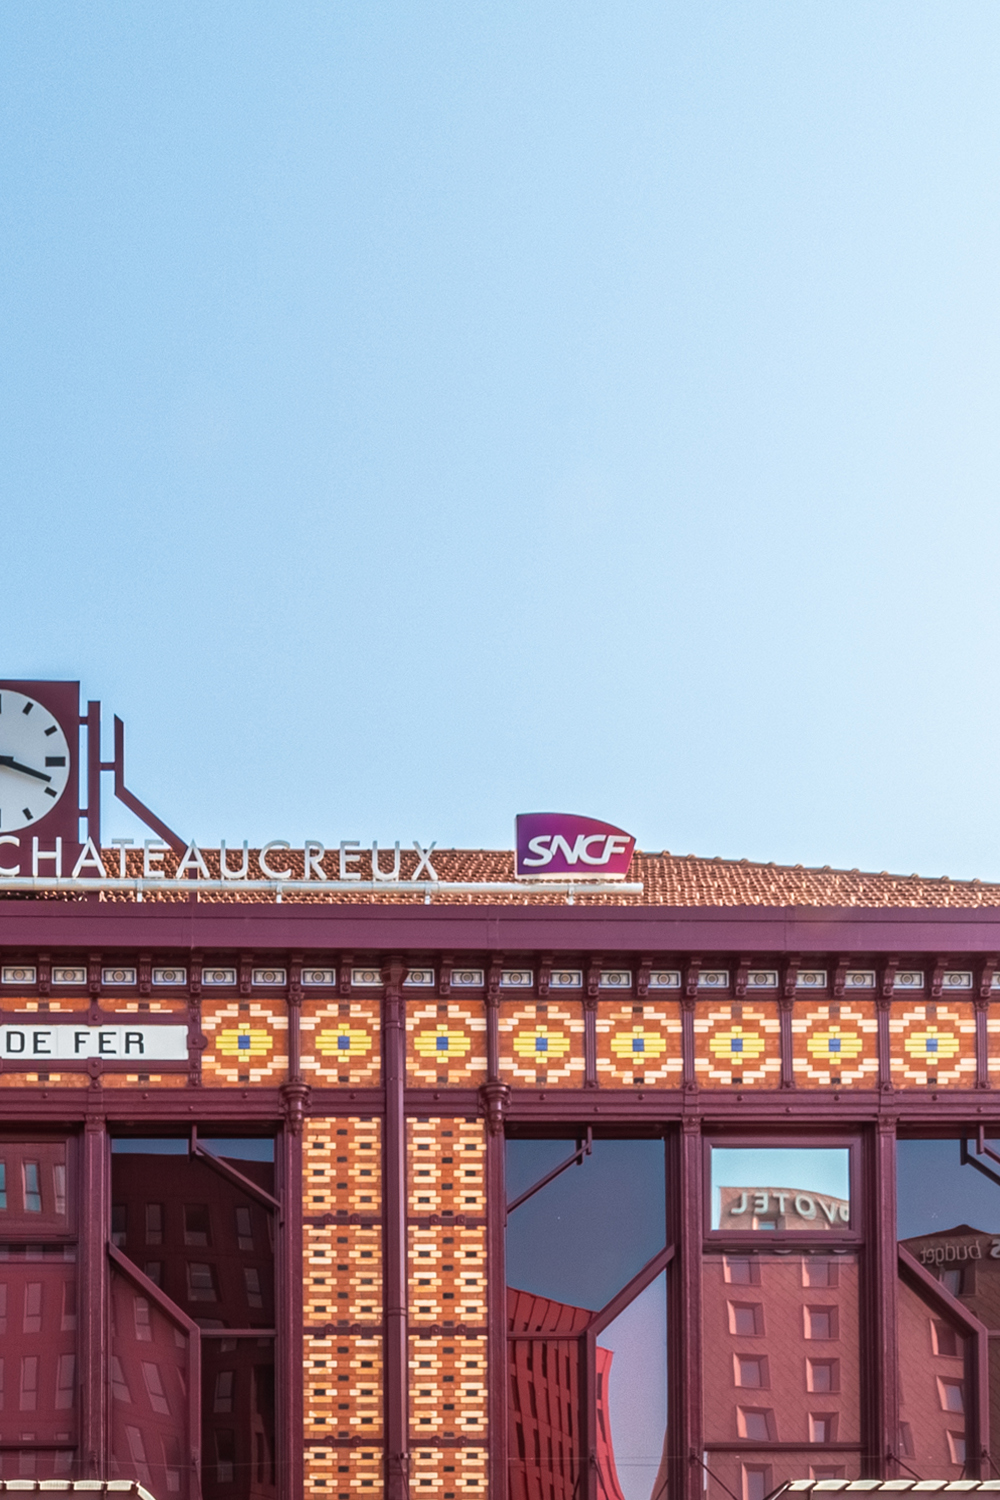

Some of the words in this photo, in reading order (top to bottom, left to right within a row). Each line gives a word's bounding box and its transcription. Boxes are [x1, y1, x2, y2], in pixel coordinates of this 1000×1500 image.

[523, 833, 632, 867] SNCF
[5, 1030, 53, 1055] DE
[73, 1030, 146, 1055] FER
